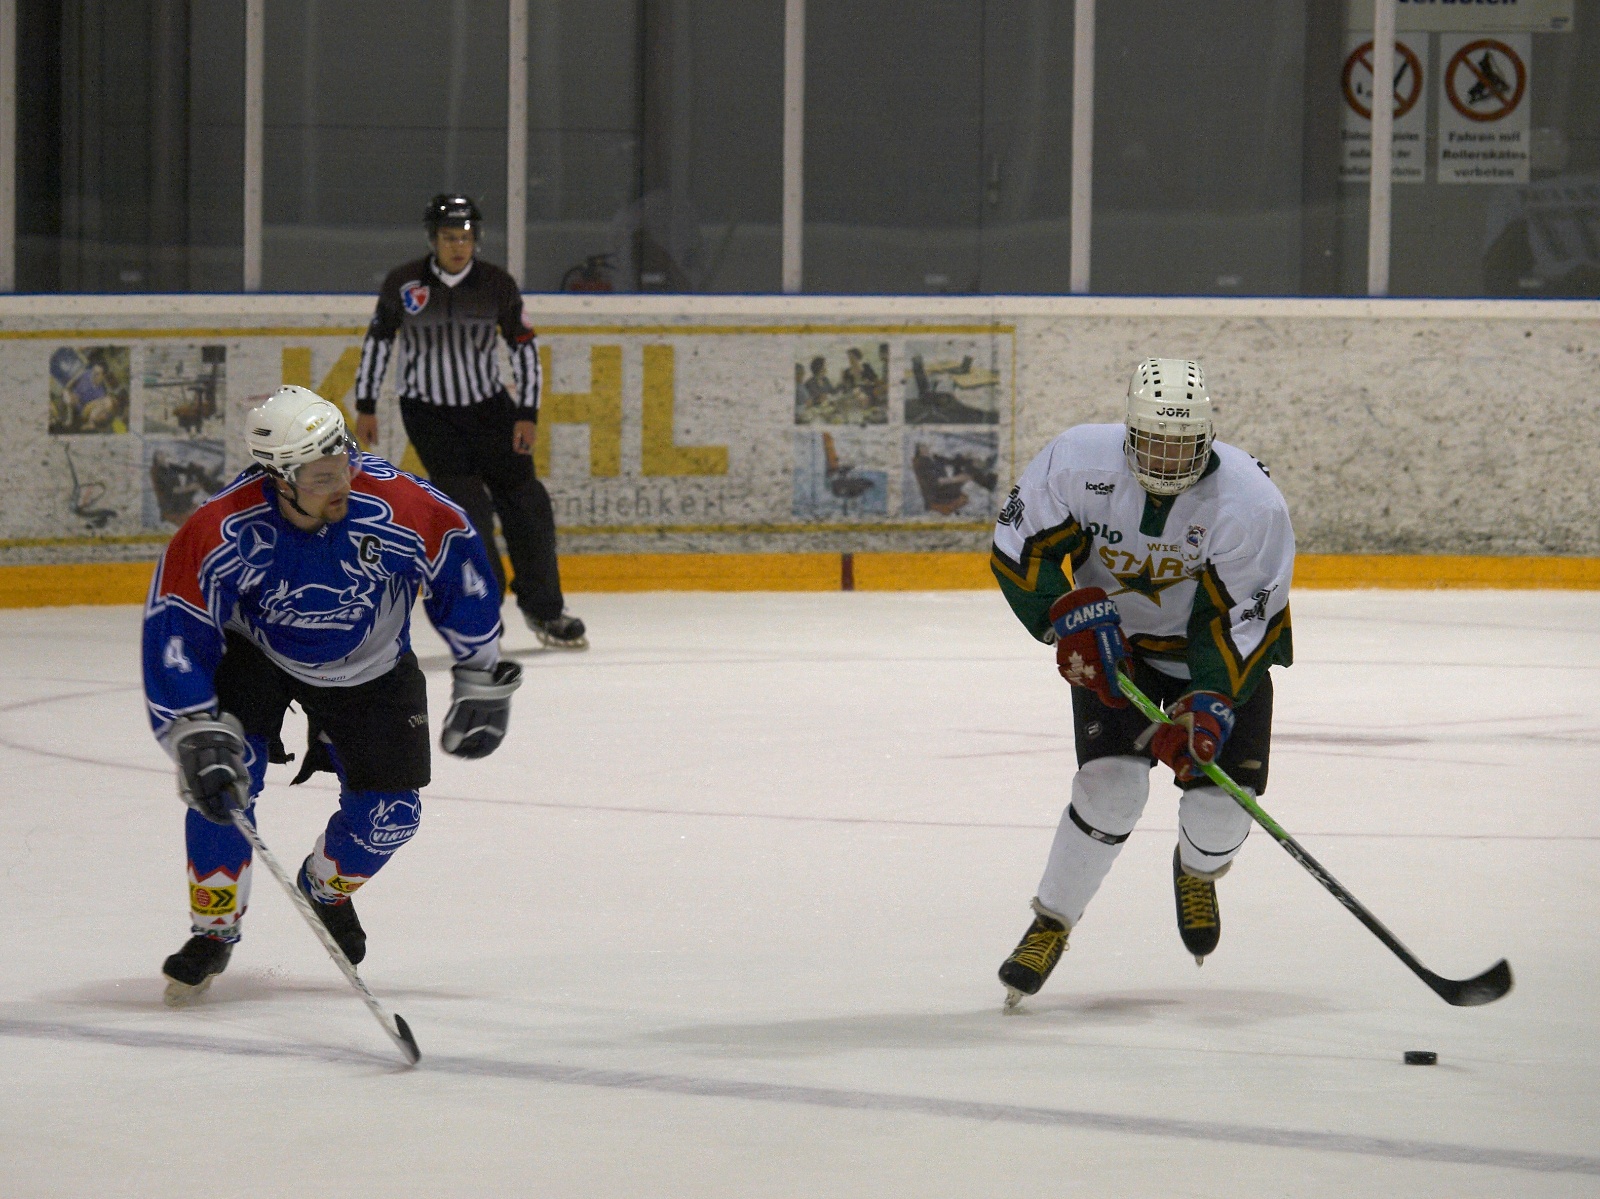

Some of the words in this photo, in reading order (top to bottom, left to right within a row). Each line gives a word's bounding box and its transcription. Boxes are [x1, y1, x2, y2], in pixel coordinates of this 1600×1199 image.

[1448, 132, 1495, 142] Fahren
[1499, 132, 1521, 142] mit
[1442, 149, 1527, 160] Rollerskates
[1454, 166, 1515, 177] verboten
[282, 345, 729, 477] KHL
[1156, 407, 1190, 418] JOFA
[1088, 522, 1123, 544] OLD
[359, 534, 382, 565] C
[460, 558, 488, 600] 4
[163, 636, 193, 675] 4
